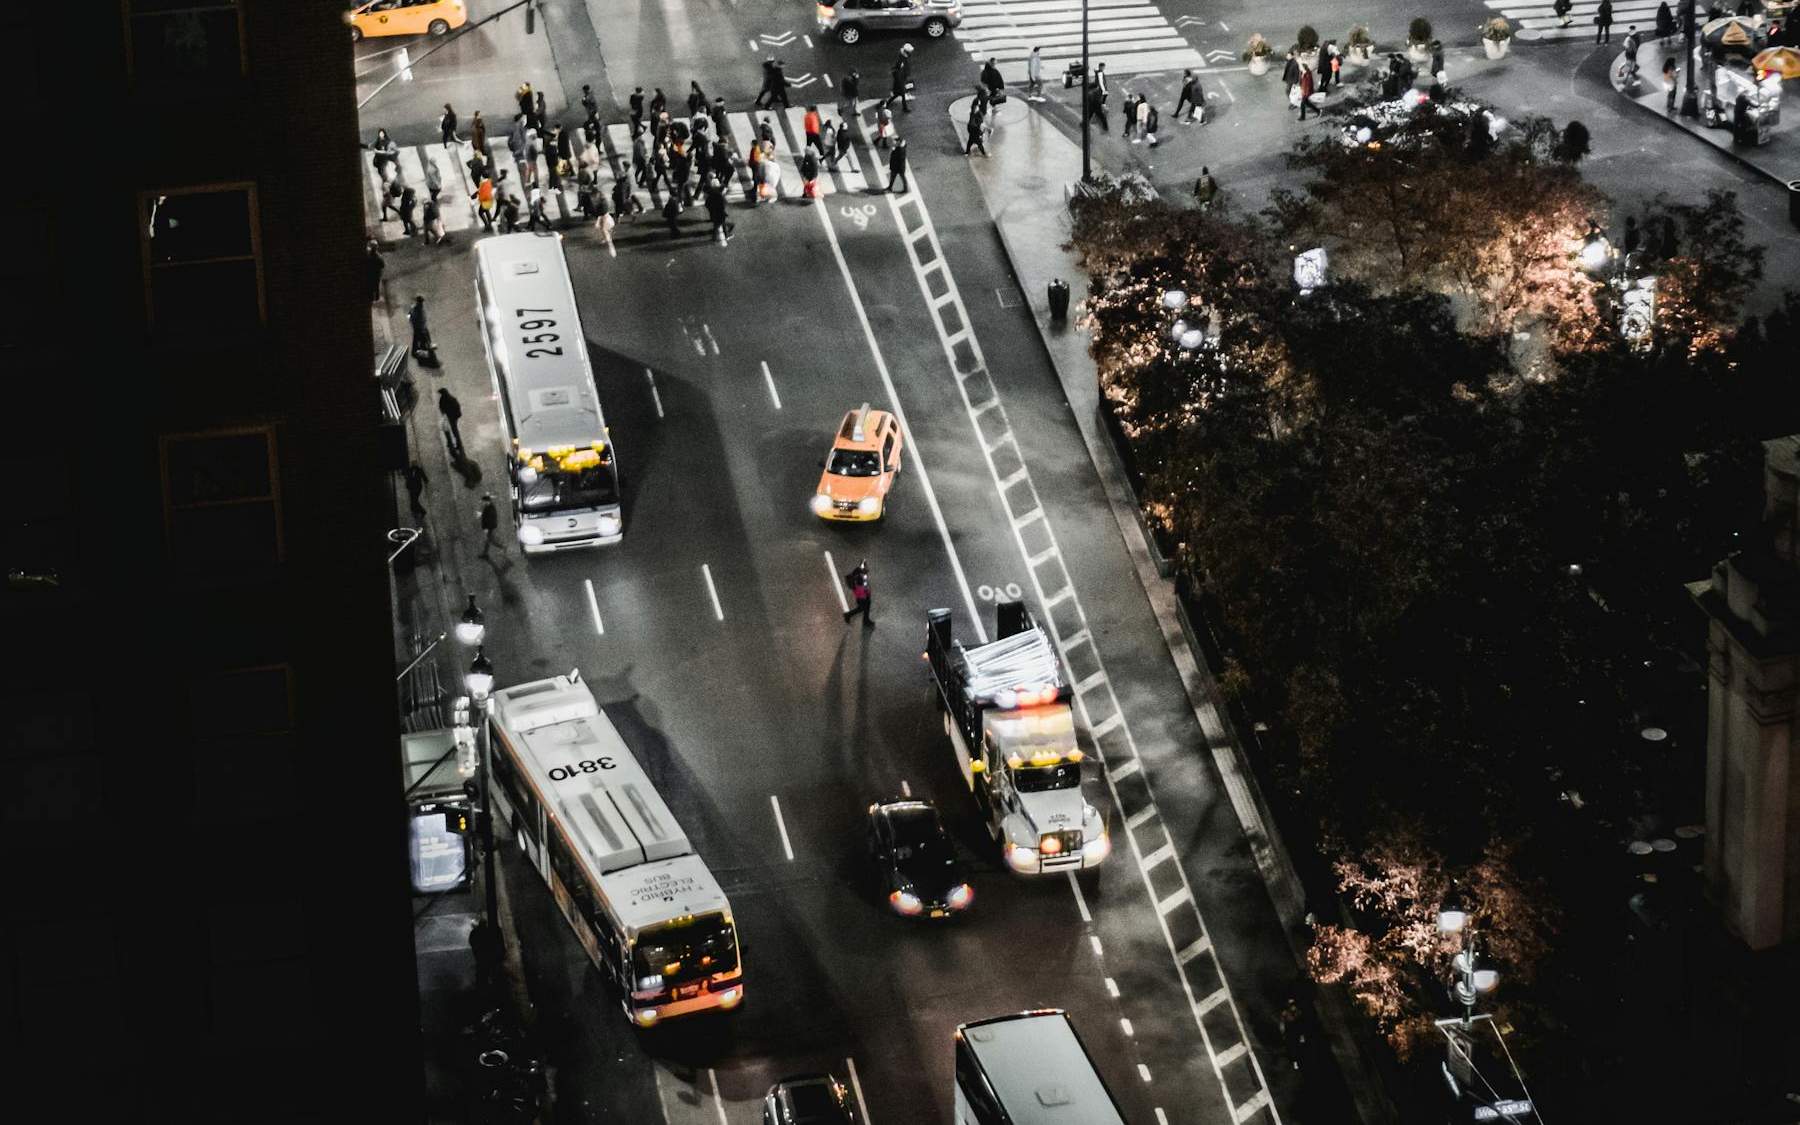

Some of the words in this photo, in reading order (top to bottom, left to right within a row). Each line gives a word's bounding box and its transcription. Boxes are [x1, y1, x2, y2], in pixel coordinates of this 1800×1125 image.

[516, 307, 564, 359] 2597
[549, 756, 617, 782] 3810
[629, 877, 695, 897] ELECTRIC
[643, 873, 671, 885] BUS
[640, 885, 693, 902] HYBRID
